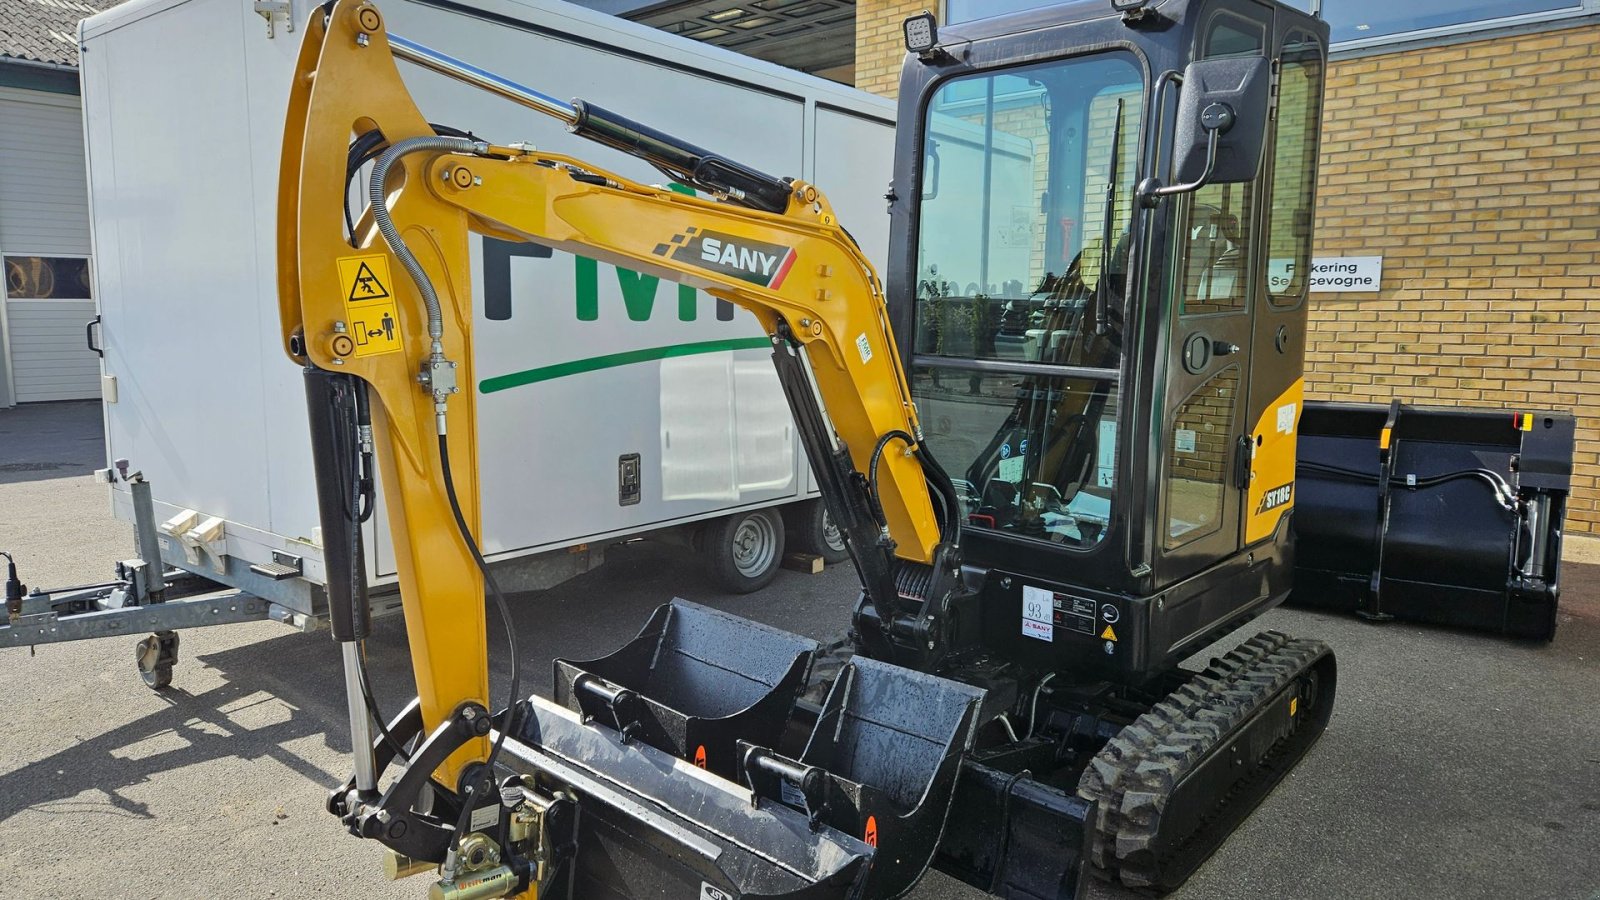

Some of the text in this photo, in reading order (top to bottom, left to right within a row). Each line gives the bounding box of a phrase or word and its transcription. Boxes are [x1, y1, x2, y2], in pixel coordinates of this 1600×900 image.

[701, 237, 777, 276] SANY
[1286, 262, 1358, 274] Pkering
[1271, 276, 1373, 287] Secevogne
[1266, 485, 1291, 508] SY18C
[1028, 601, 1042, 619] 93
[1032, 622, 1051, 632] SANY
